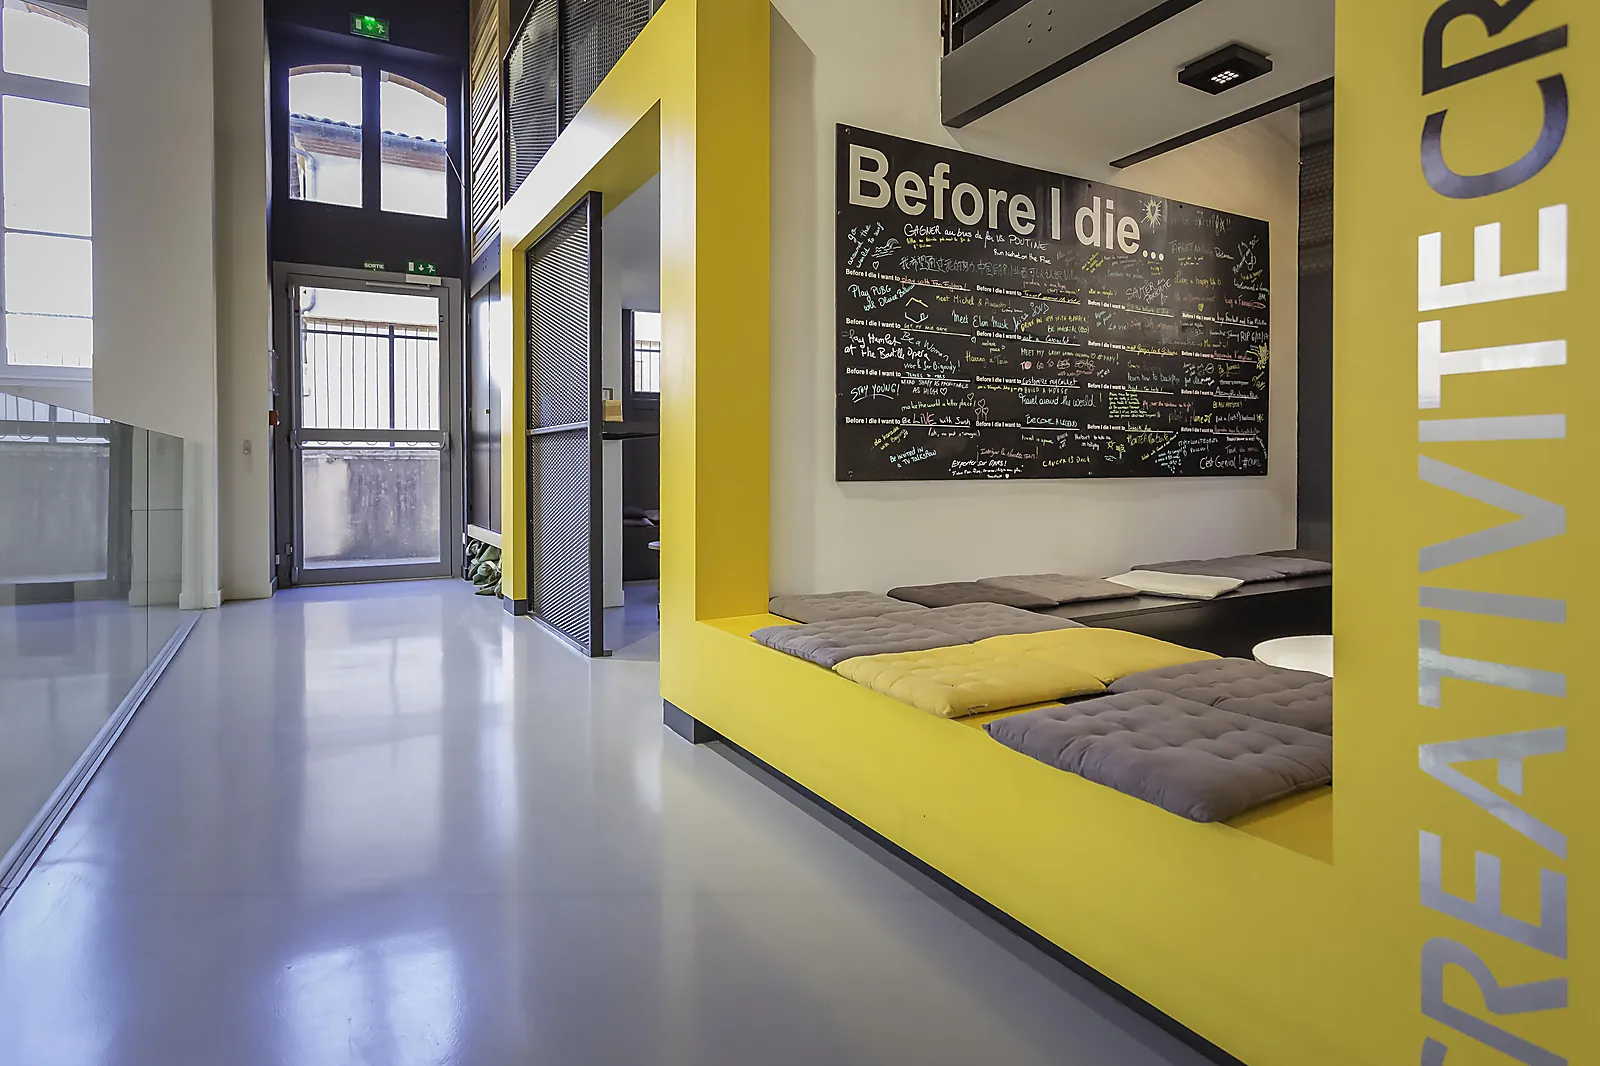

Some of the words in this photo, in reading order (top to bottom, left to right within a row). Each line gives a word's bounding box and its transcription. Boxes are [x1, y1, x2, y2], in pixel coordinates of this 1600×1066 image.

[849, 143, 1036, 235] Before
[1051, 187, 1060, 240] I
[904, 223, 941, 236] GAGNER
[846, 268, 864, 277] Before
[845, 344, 856, 355] at
[861, 347, 876, 358] the
[851, 384, 868, 400] STAY
[872, 384, 900, 399] YOUNG!
[1417, 203, 1570, 1066] REATIVITE
